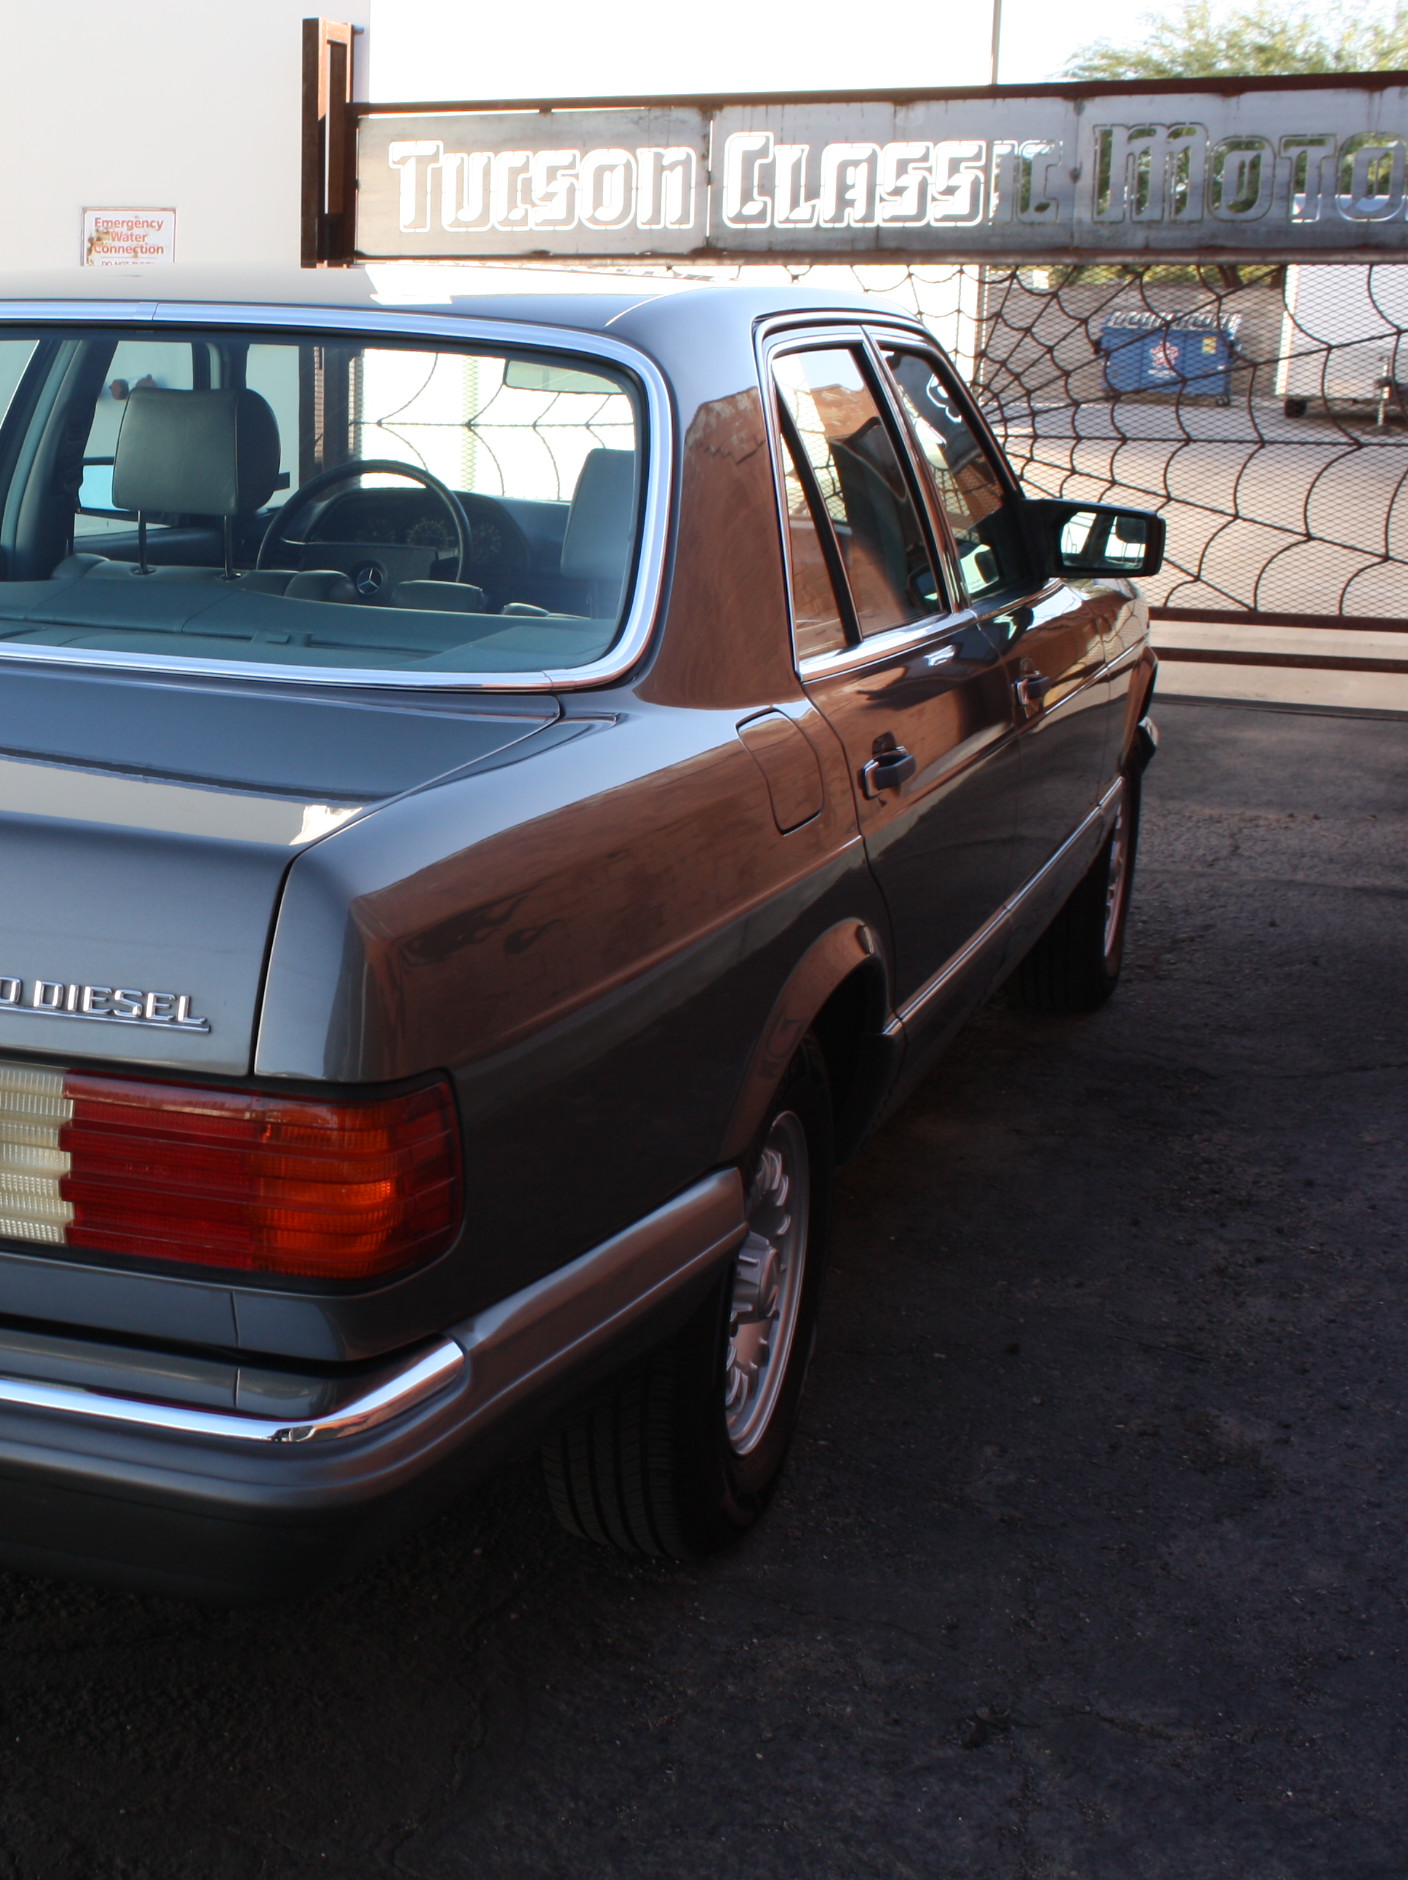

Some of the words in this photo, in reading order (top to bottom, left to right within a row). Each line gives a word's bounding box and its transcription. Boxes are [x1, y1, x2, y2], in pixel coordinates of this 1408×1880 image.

[94, 217, 164, 231] Emergency
[110, 231, 148, 242] Water
[93, 243, 165, 254] Connection
[33, 979, 208, 1025] DIESEL
